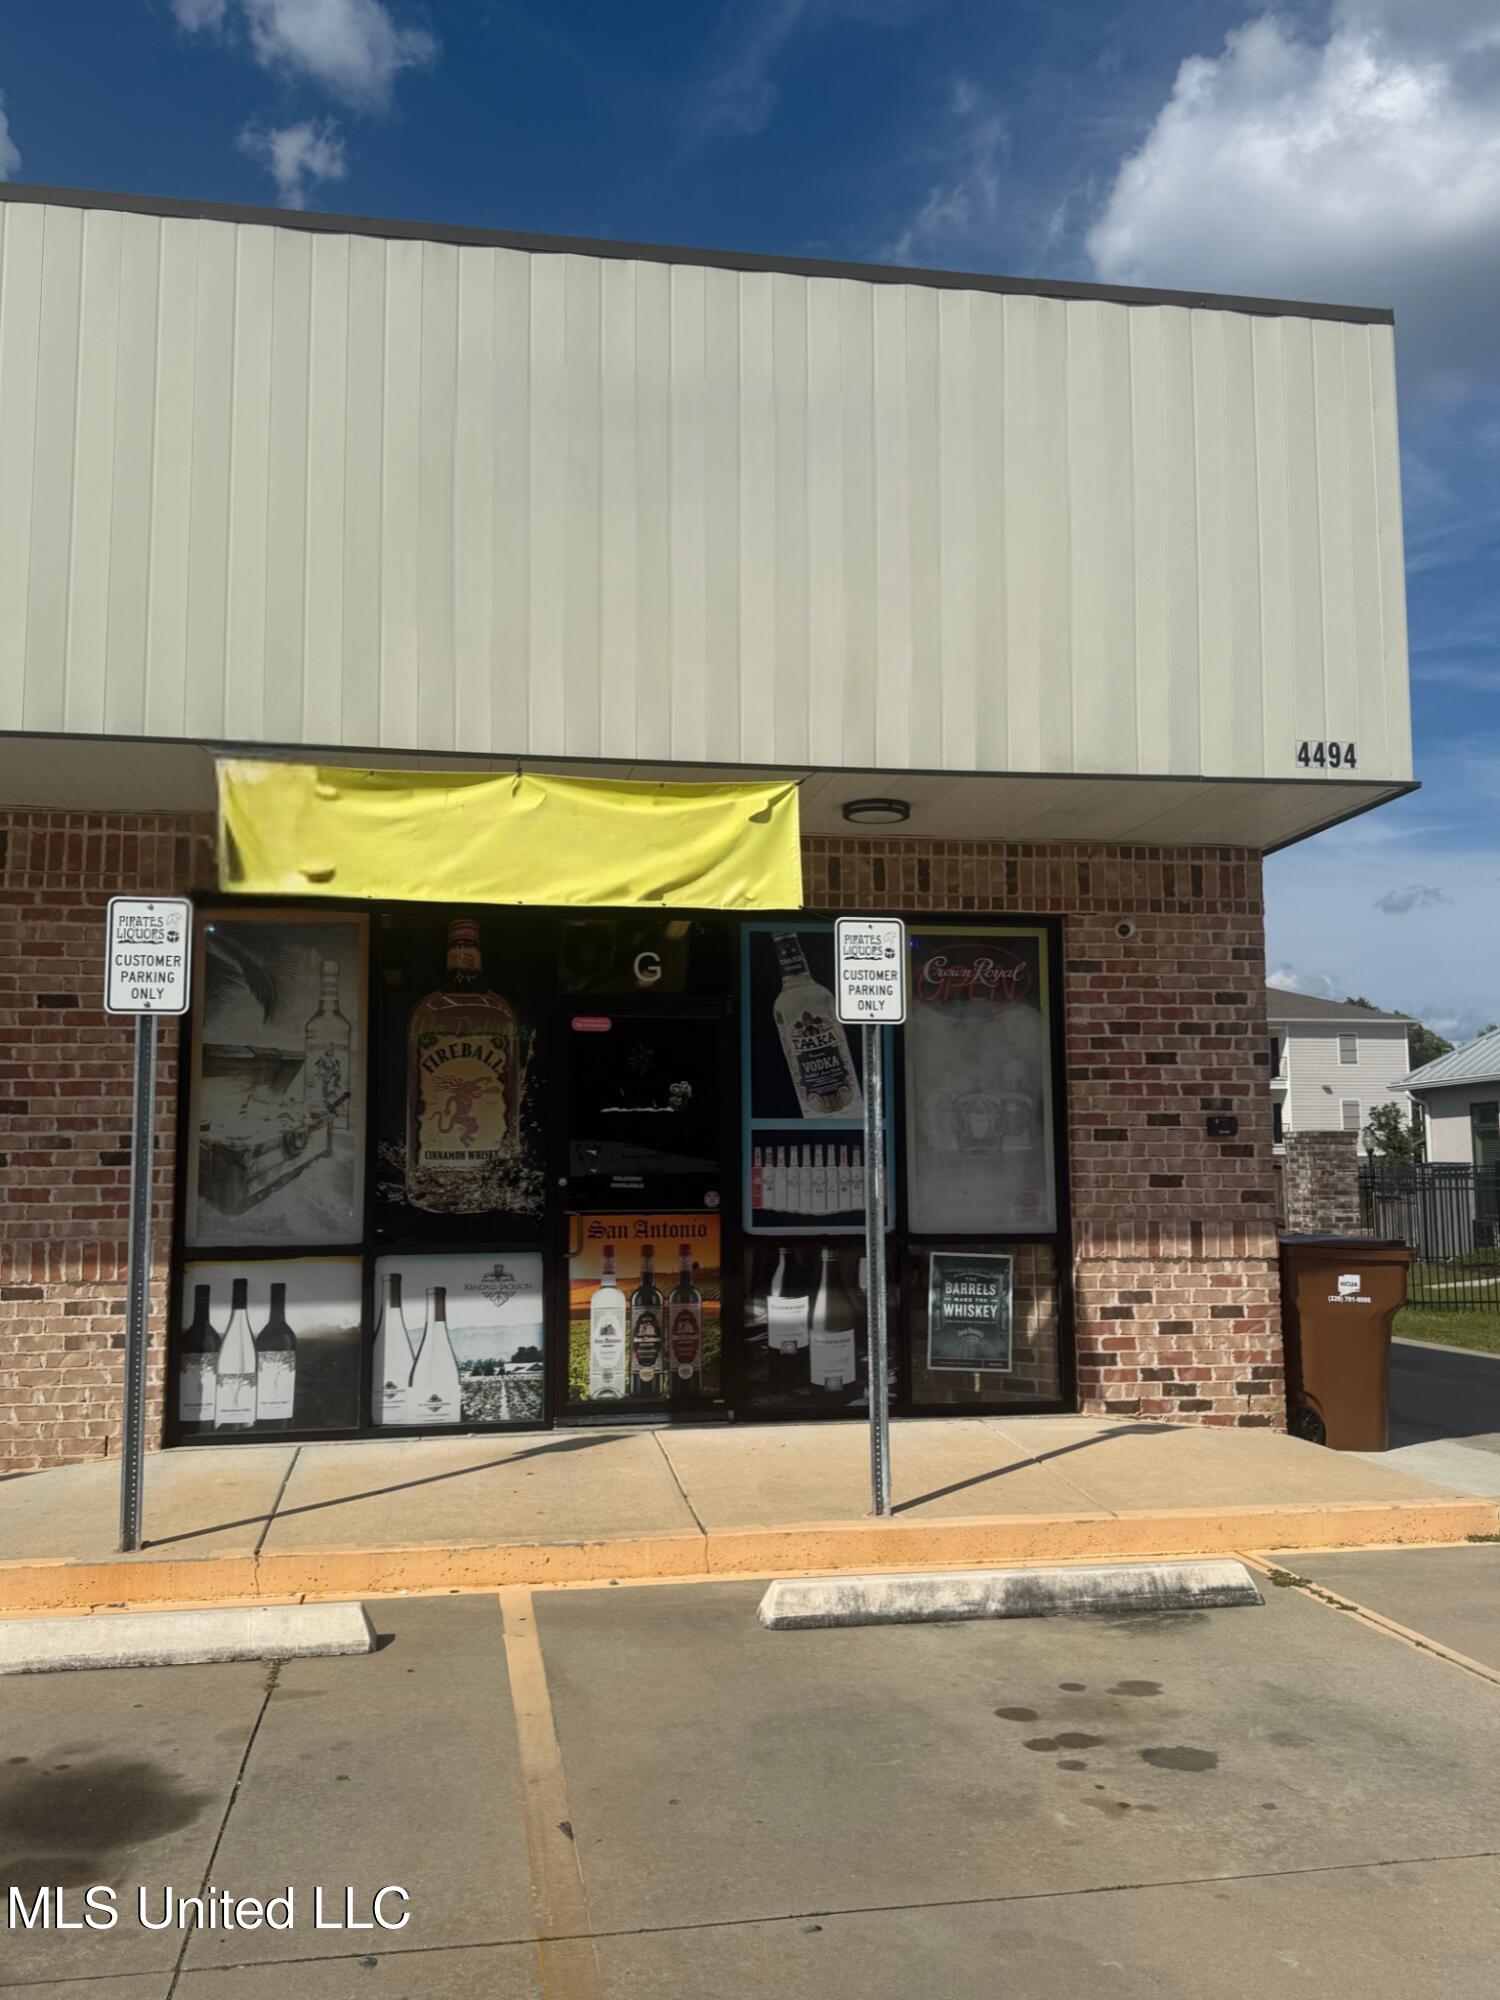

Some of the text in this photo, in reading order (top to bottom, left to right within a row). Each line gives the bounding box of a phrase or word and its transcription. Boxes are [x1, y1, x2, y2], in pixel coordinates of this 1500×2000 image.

[1297, 741, 1357, 769] 4494
[118, 915, 164, 928] PIRATES
[116, 927, 165, 940] LIQUORS
[843, 934, 882, 945] PIRATES
[842, 945, 883, 956] LIQUORS
[114, 954, 182, 967] CUSTOMER
[633, 951, 662, 982] G
[120, 971, 175, 984] PARKING
[842, 969, 898, 981] CUSTOMER
[923, 955, 1027, 988] Crown Royal
[131, 987, 165, 1000] ONLY
[848, 984, 893, 996] PARKING
[857, 999, 886, 1011] ONLY
[792, 1030, 837, 1050] TAAKA
[422, 1043, 505, 1084] FIREBALL
[801, 1055, 841, 1073] VODKA
[424, 1150, 466, 1161] CINNAMON
[588, 1219, 707, 1239] San Antonio
[945, 1281, 996, 1296] BARRELS
[943, 1303, 998, 1319] WHISKEY
